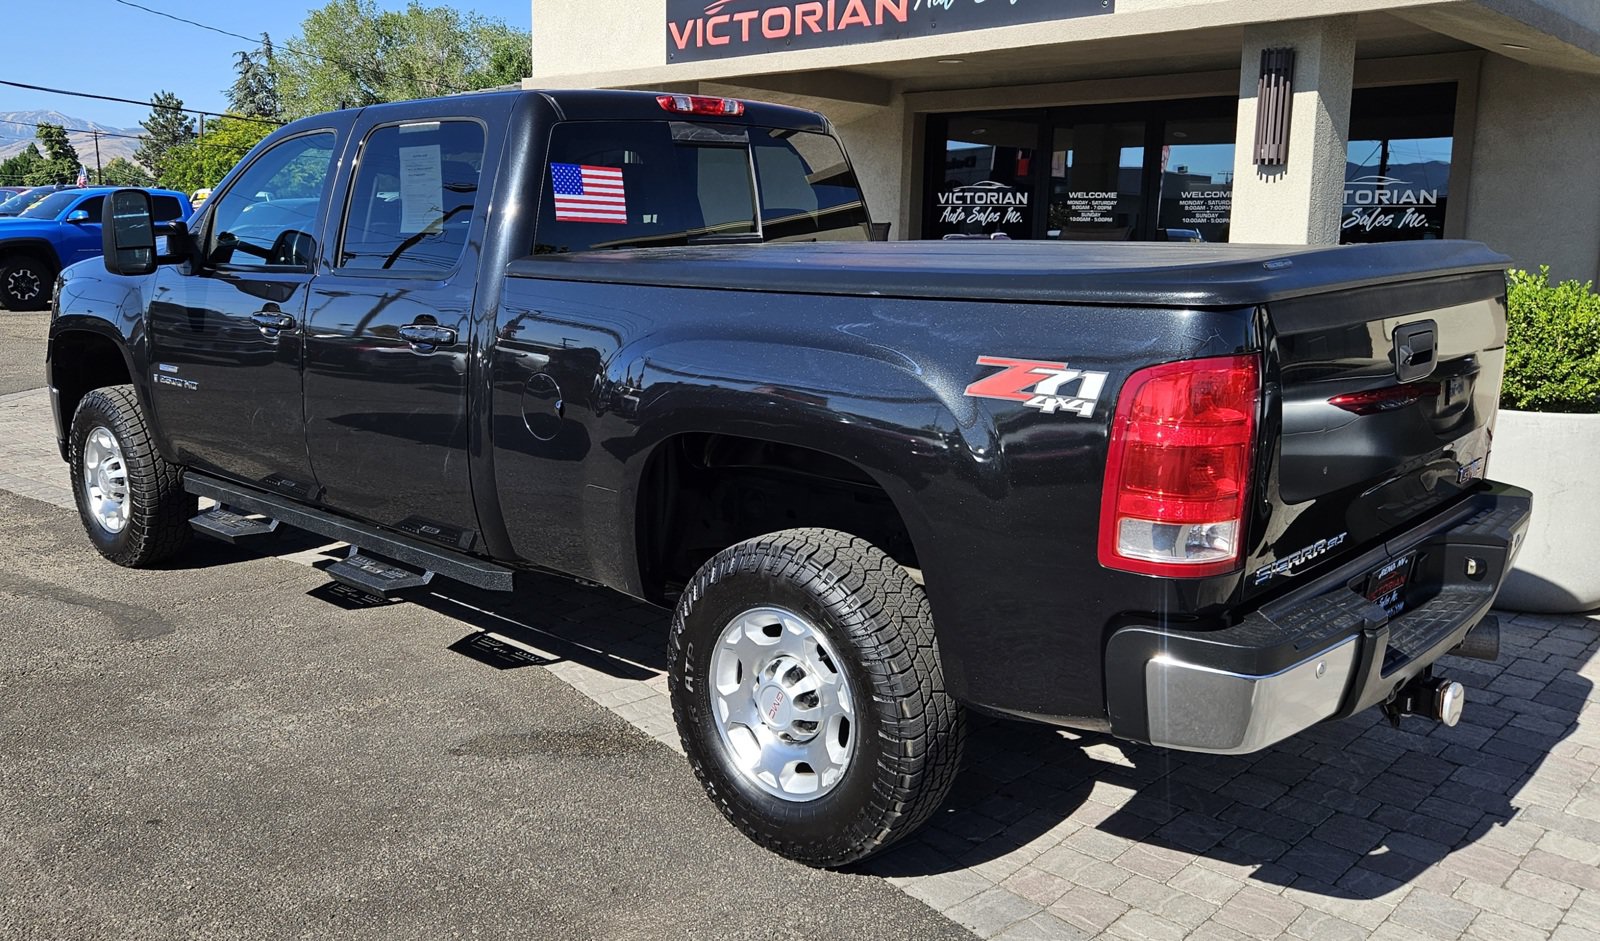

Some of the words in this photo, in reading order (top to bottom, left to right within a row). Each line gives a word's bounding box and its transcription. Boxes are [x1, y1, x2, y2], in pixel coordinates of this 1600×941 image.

[668, 0, 908, 50] VICTORIAN
[937, 191, 1028, 205] VICTORIAN
[1068, 191, 1118, 199] WELCOME
[1343, 189, 1437, 204] TORIAN
[940, 206, 966, 224] Auto
[967, 206, 1001, 226] Sales
[1002, 206, 1023, 224] Inc.
[1342, 207, 1395, 232] Sales
[1397, 207, 1429, 229] Inc.
[963, 355, 1109, 402] Z71
[1255, 538, 1327, 586] SIERRA
[768, 691, 784, 720] GMC
